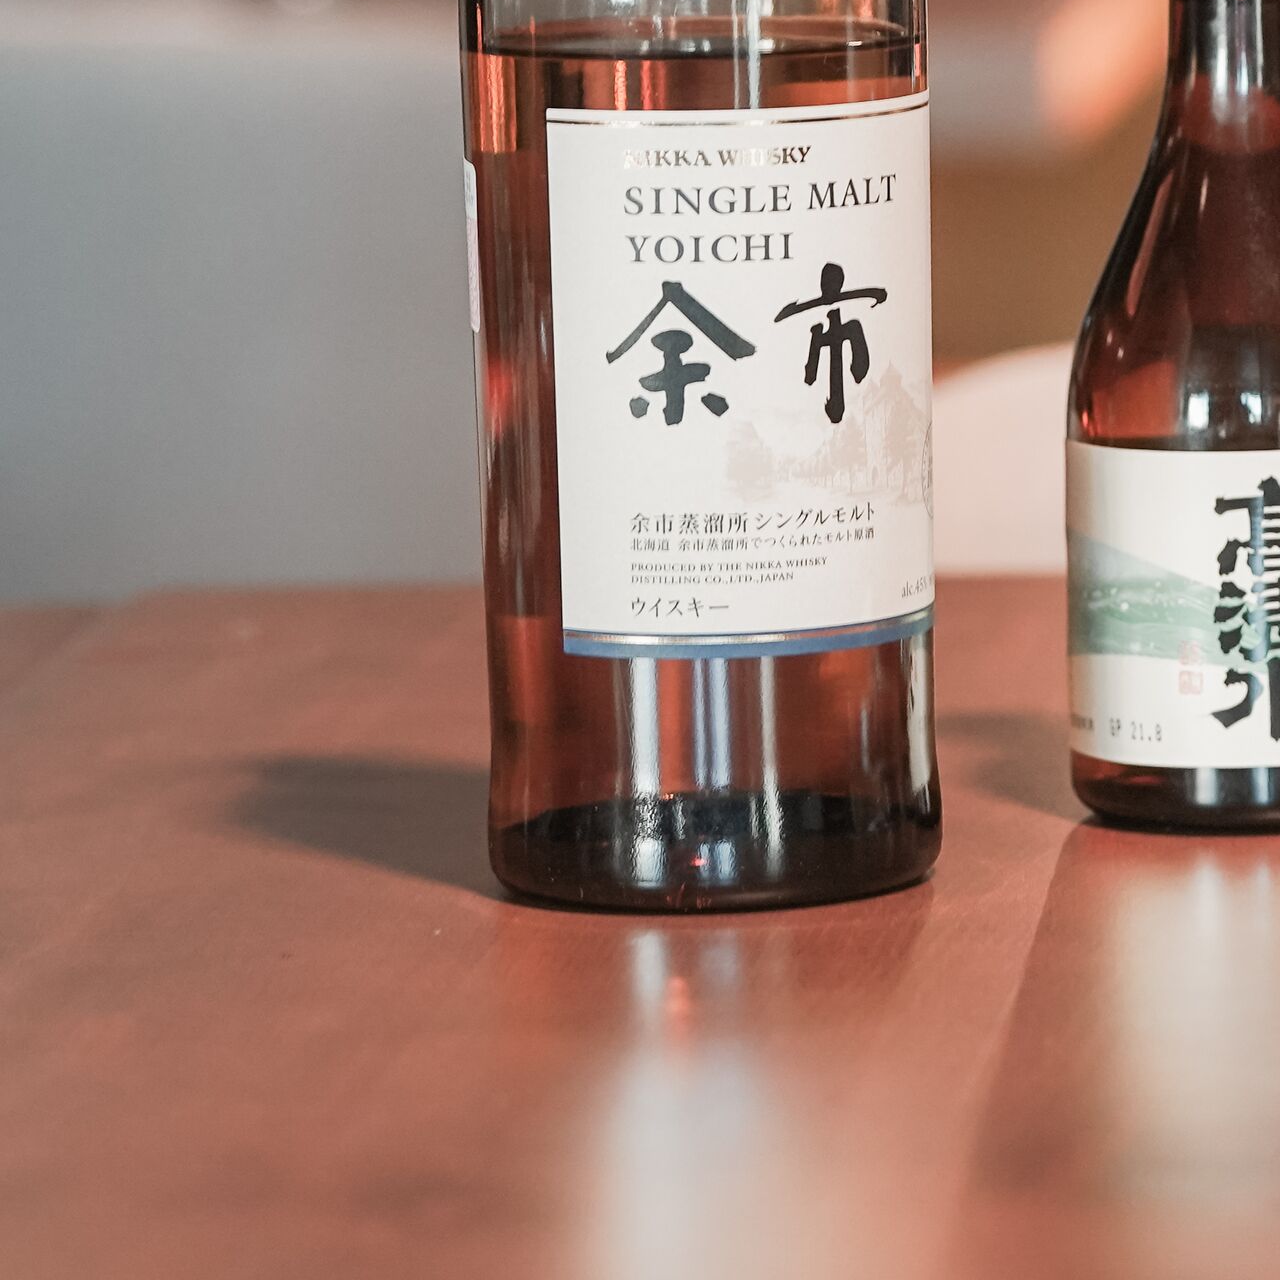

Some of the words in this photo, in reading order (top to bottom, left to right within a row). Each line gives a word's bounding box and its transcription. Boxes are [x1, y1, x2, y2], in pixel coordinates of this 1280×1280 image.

[623, 149, 712, 168] NIKKA
[717, 146, 811, 167] WHISKY
[623, 184, 792, 216] SINGLE
[807, 173, 896, 210] MALT
[625, 232, 794, 264] YOICHI
[605, 261, 888, 426] 余市
[630, 502, 875, 535] 余市蒸溜所シングルモルト
[630, 537, 670, 552] 北海道
[631, 562, 696, 572] PRODUCED
[700, 561, 714, 571] BY
[719, 561, 742, 571] THE
[746, 559, 783, 570] NIKKA
[786, 556, 829, 568] WHISKY
[631, 574, 701, 584] DISTILLING
[631, 596, 730, 618] ウイスキー
